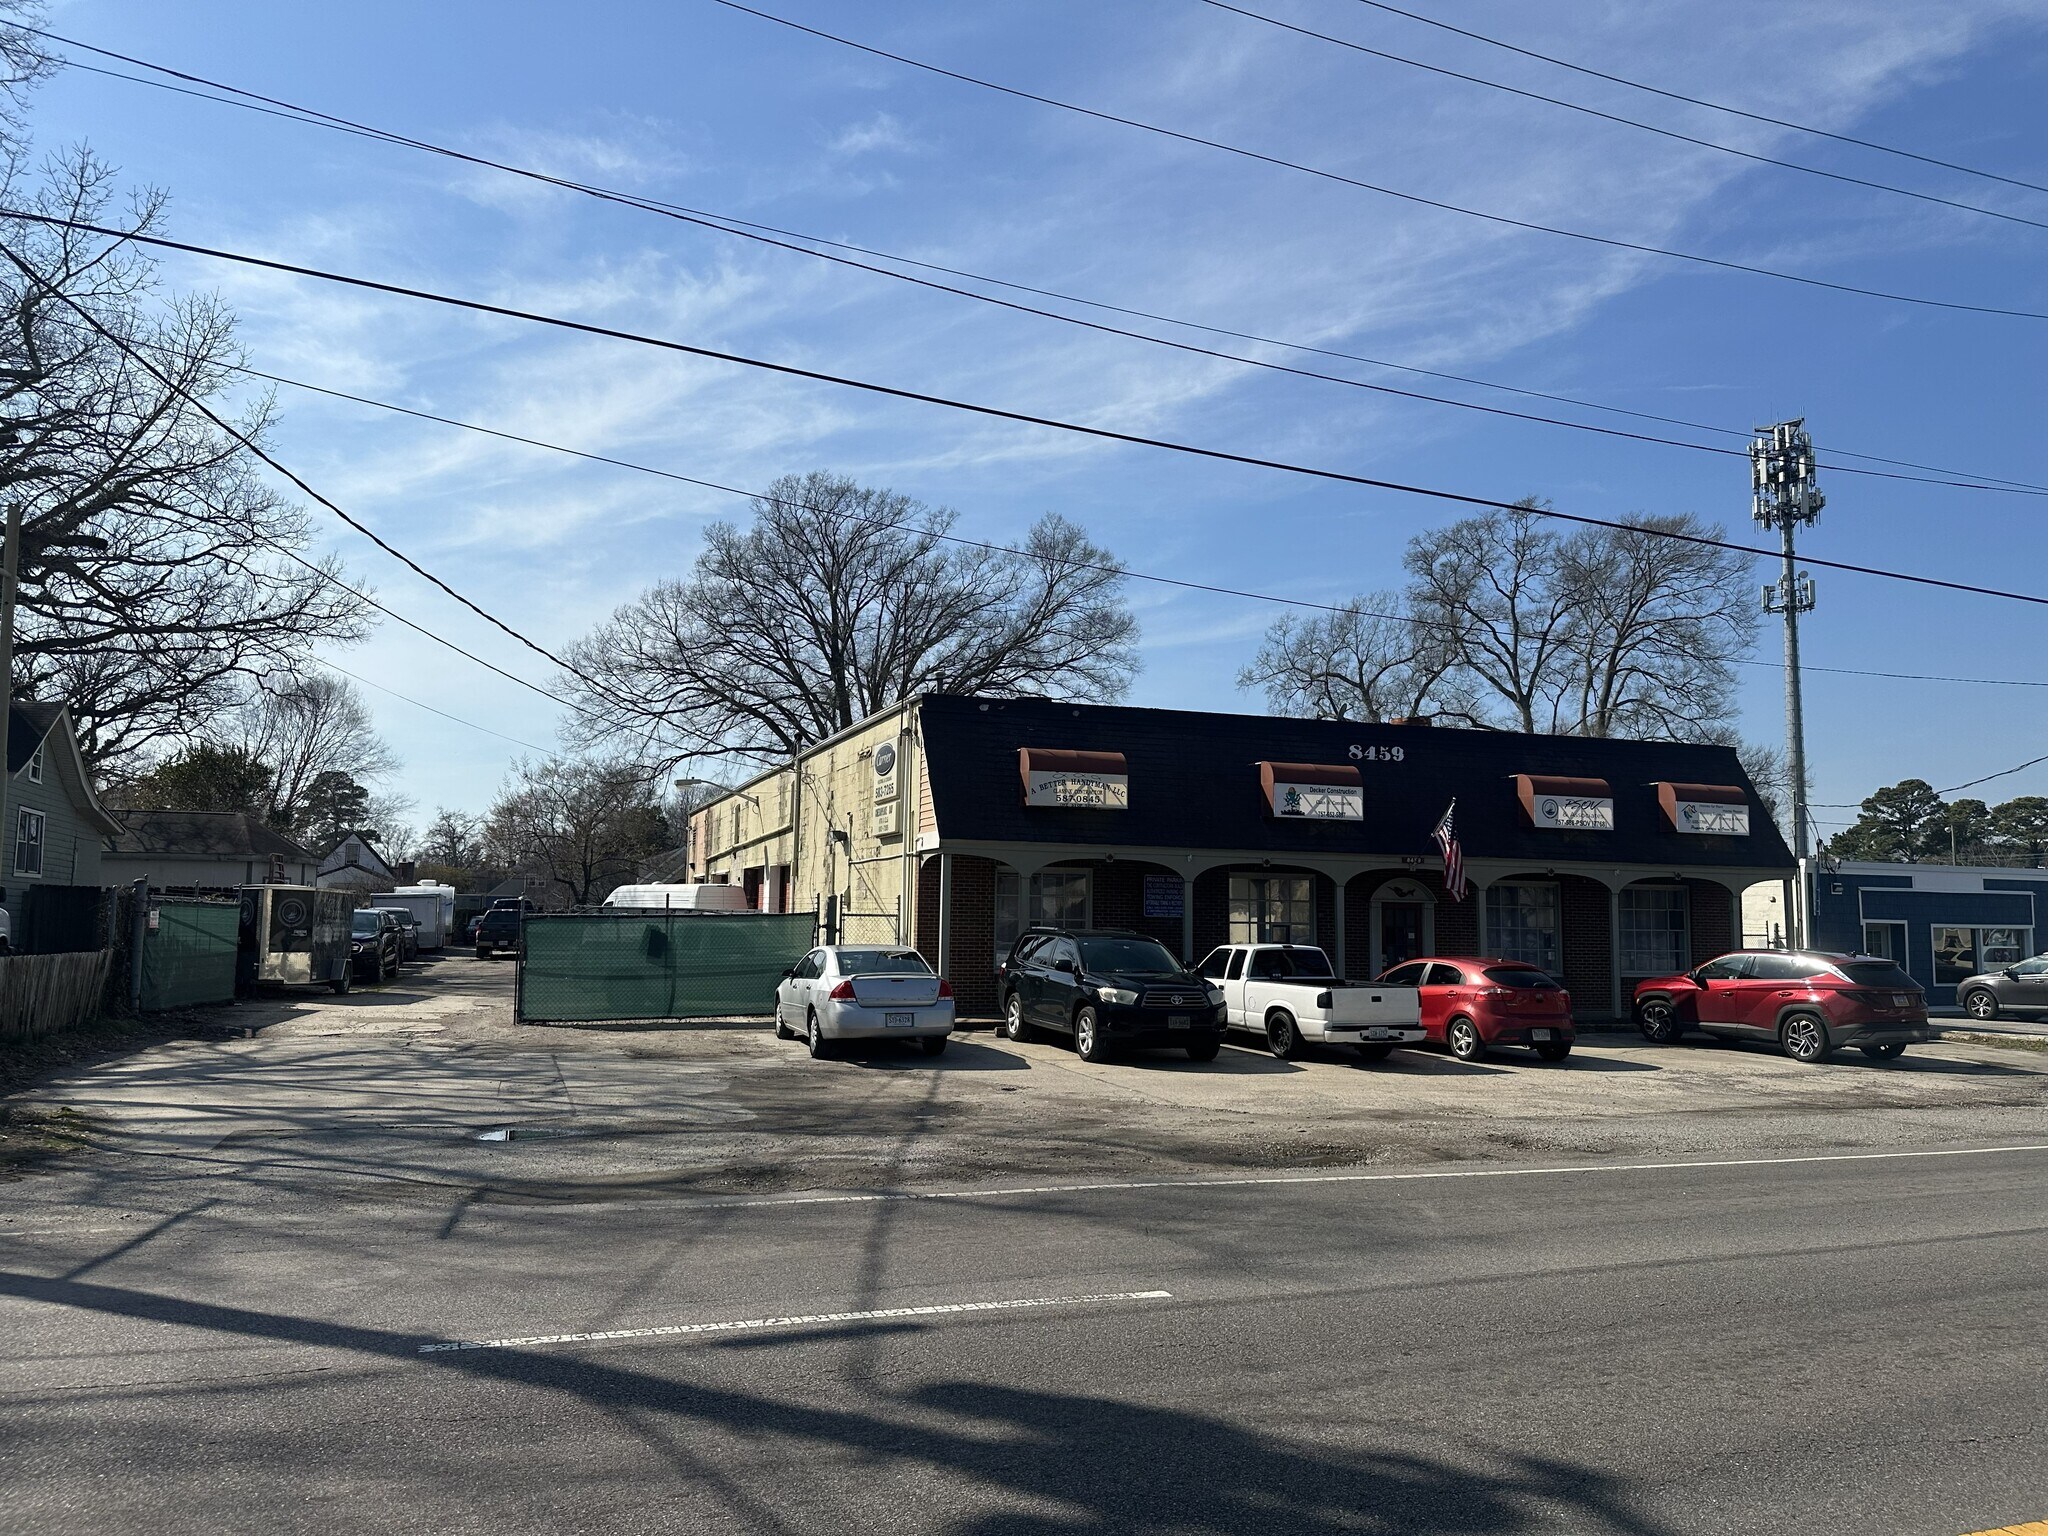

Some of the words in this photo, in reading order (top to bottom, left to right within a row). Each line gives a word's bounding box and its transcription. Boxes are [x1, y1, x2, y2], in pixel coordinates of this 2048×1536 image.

[1348, 744, 1404, 762] 8459
[1039, 779, 1067, 791] BETTER
[1113, 787, 1125, 797] LLC
